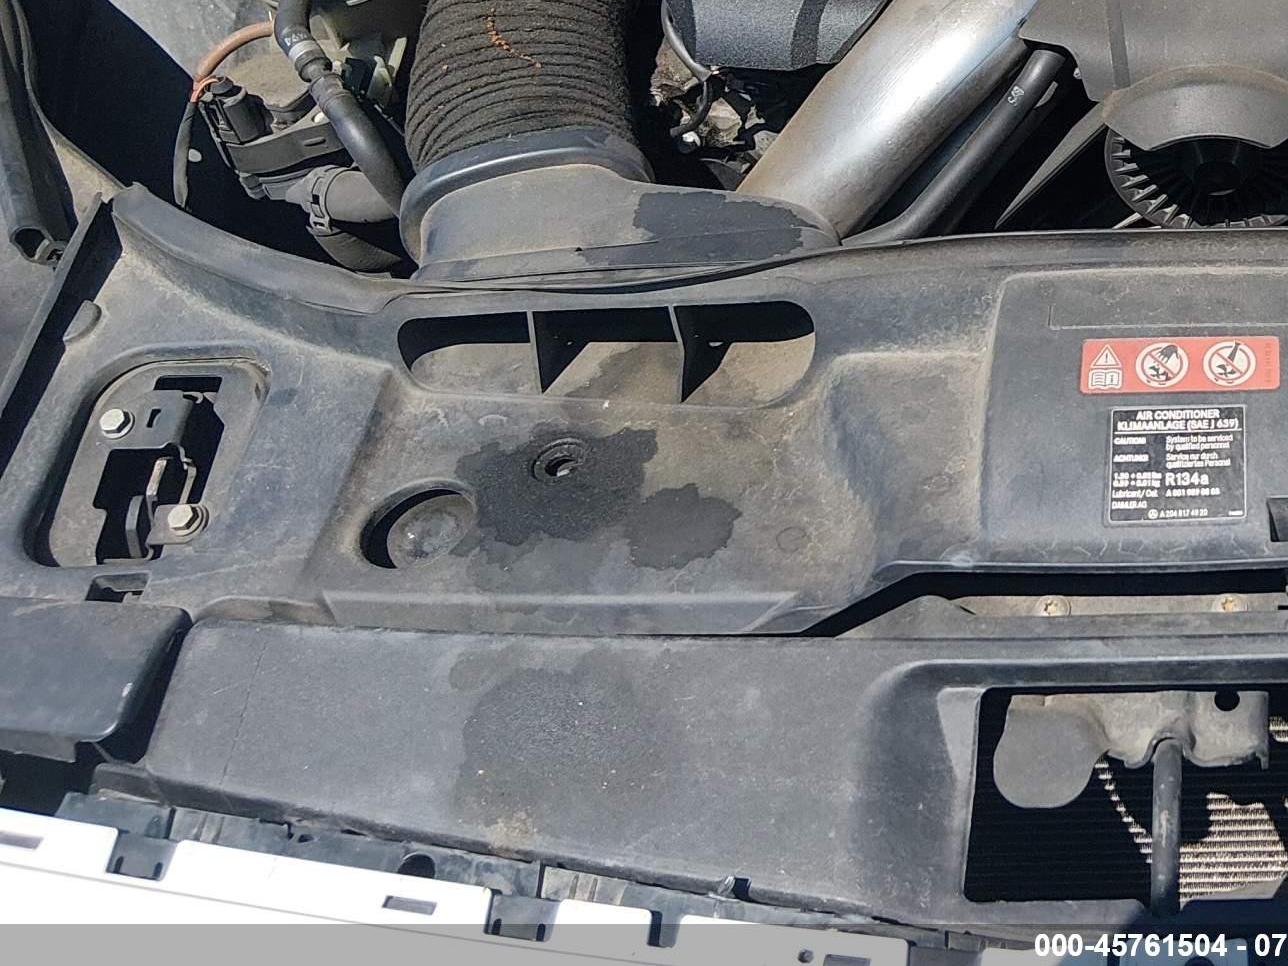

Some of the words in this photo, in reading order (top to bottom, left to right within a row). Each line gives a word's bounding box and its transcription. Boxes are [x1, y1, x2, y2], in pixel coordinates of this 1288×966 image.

[1136, 411, 1153, 421] AIR
[1154, 409, 1220, 420] CONDITIONER
[1117, 420, 1186, 431] KLIMAANLAGE
[1186, 419, 1209, 432] (SAE
[1166, 434, 1190, 444] System
[1190, 434, 1198, 443] to
[1198, 434, 1207, 443] be
[1164, 471, 1210, 487] R134a
[1159, 509, 1165, 518] A
